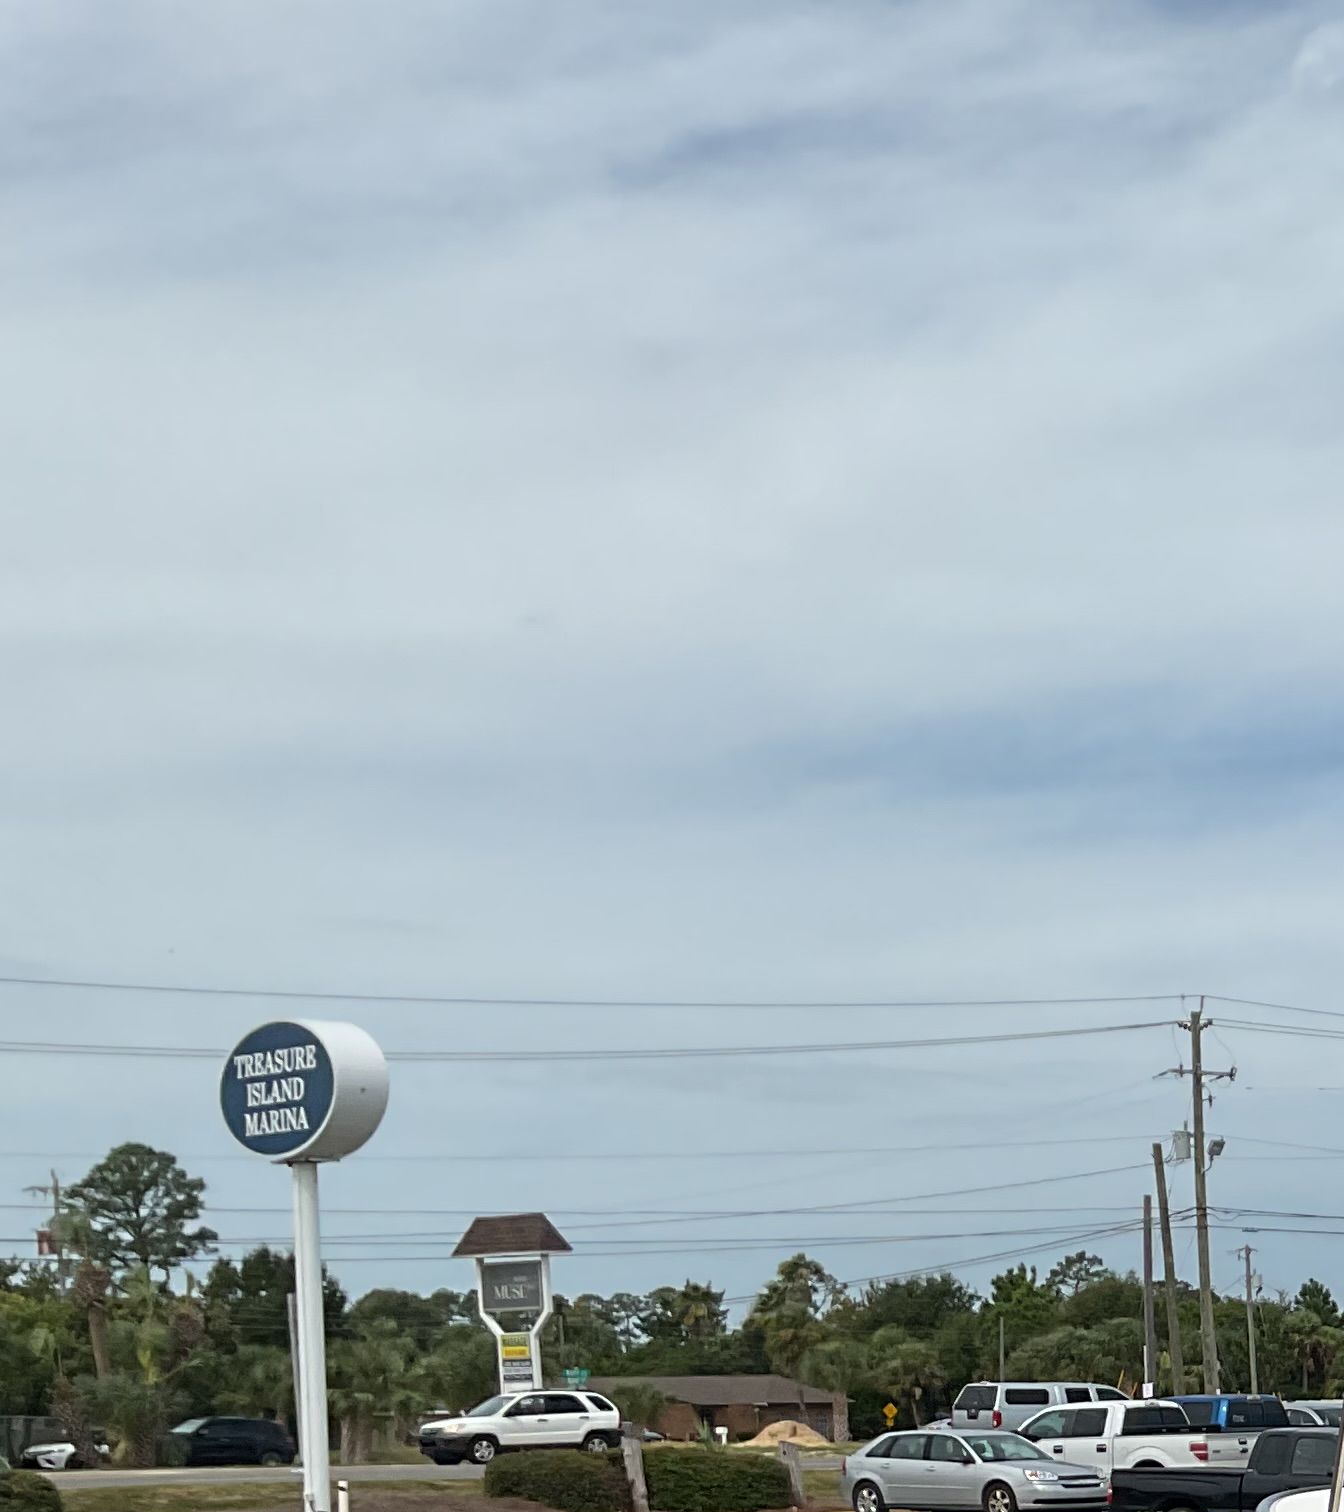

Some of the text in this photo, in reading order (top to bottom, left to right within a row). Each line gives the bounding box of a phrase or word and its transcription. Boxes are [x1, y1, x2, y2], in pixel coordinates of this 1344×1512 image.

[234, 1045, 317, 1079] TREASURE
[246, 1077, 305, 1107] ISLAND
[244, 1106, 309, 1137] MARINA
